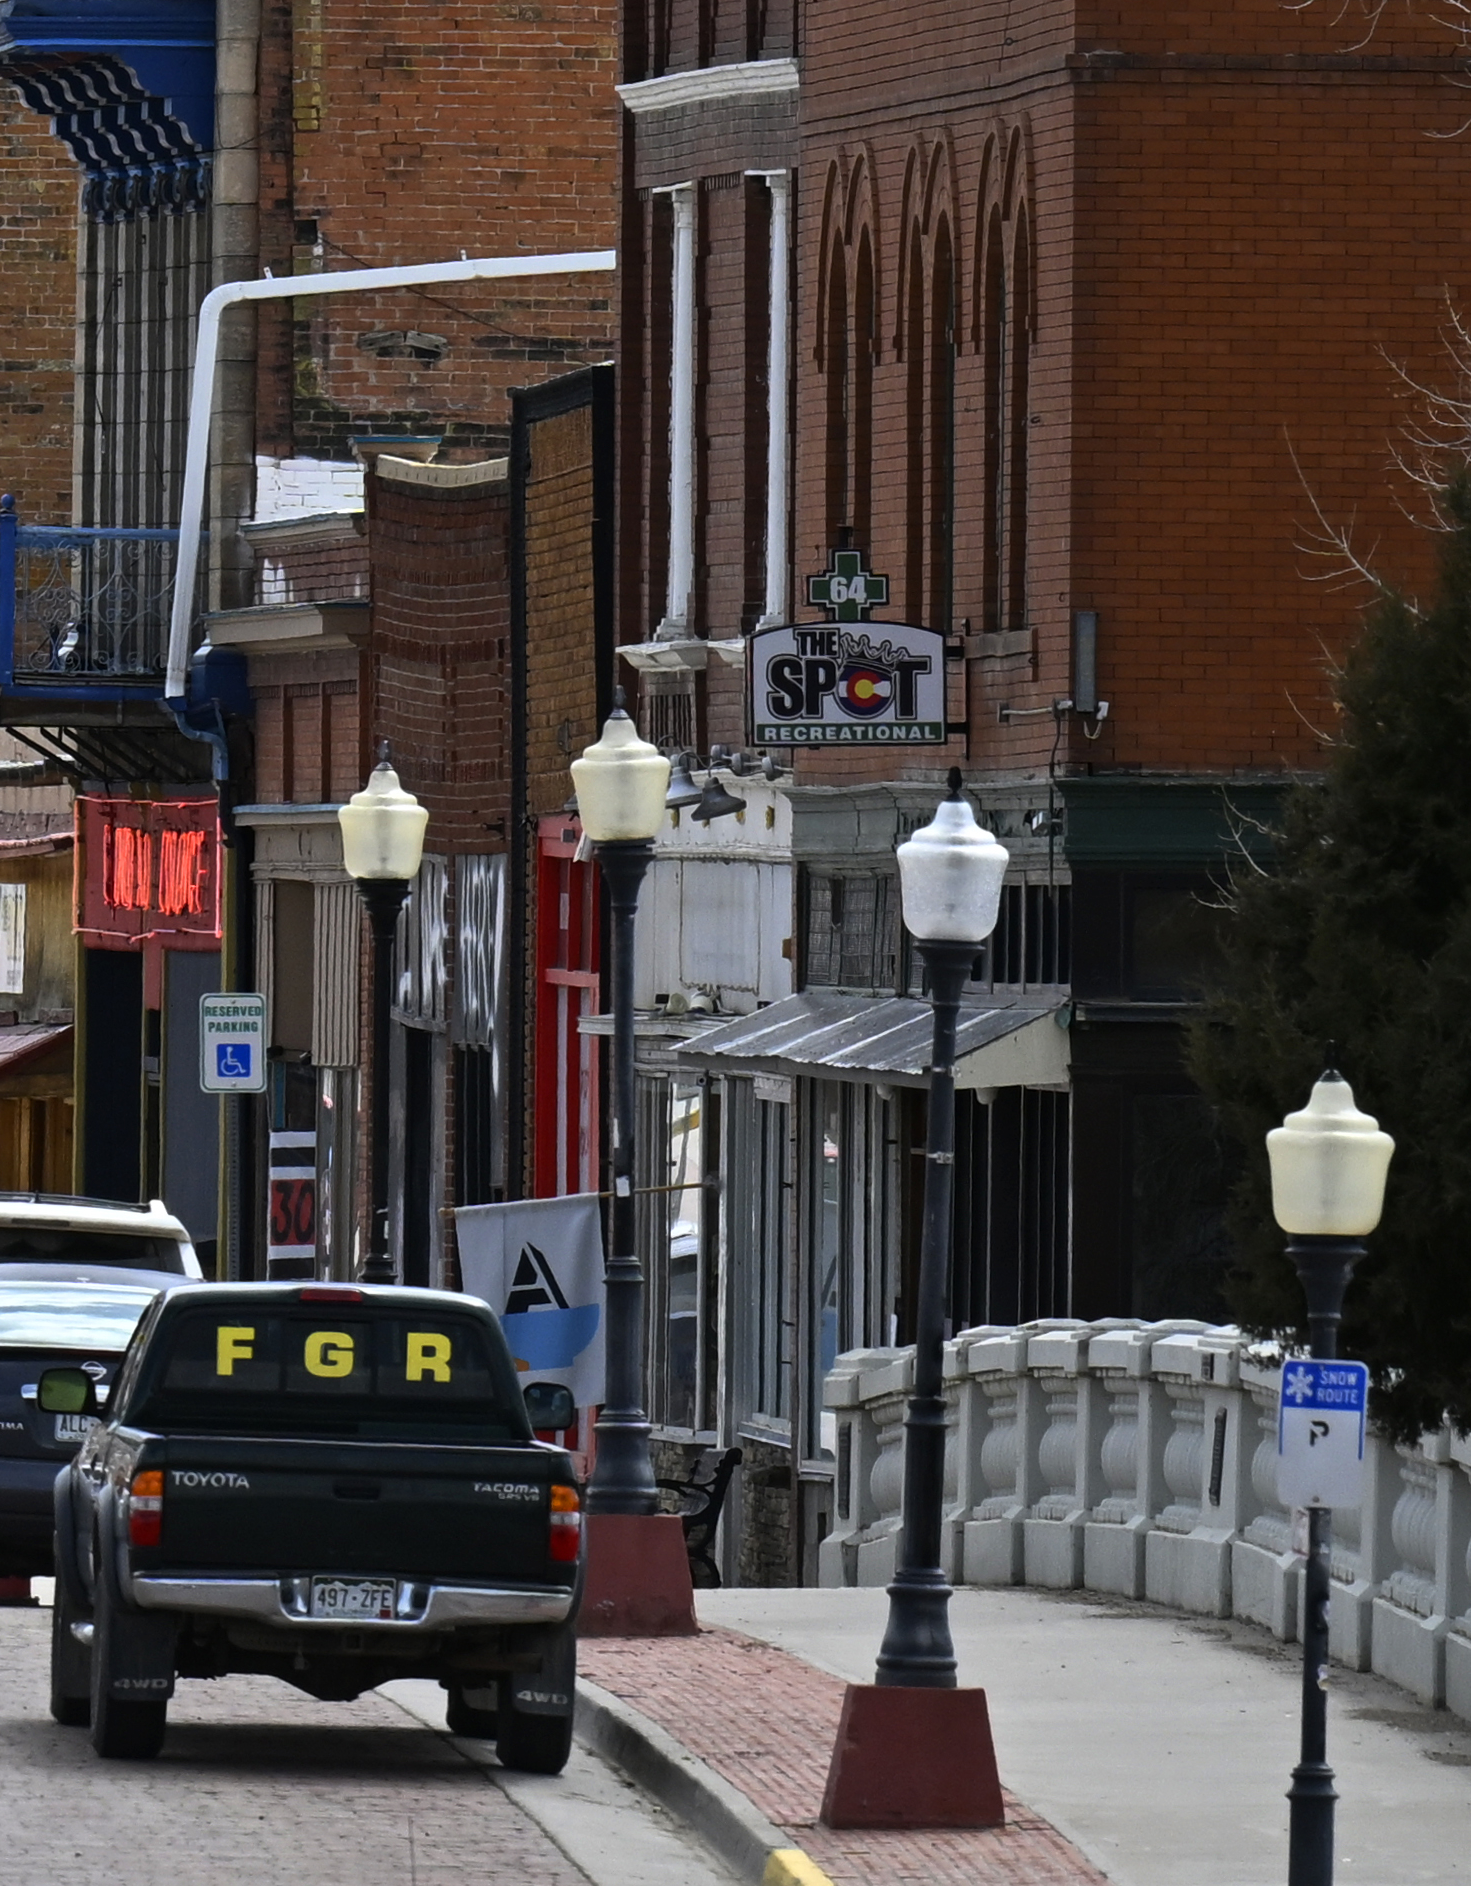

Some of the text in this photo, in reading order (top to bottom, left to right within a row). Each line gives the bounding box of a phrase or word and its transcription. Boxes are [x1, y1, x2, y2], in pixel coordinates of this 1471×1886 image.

[829, 576, 867, 603] 64
[795, 629, 839, 658] THE
[764, 724, 936, 741] RECREATIONAL
[204, 1005, 262, 1017] RESERVED
[208, 1021, 258, 1033] PARKING
[1320, 1370, 1357, 1385] SNOW
[1317, 1388, 1358, 1404] ROUTE
[170, 1469, 250, 1490] TOYOTA
[473, 1482, 540, 1494] TACOMA
[113, 1677, 169, 1690] 4WD
[515, 1689, 569, 1706] 4WD
